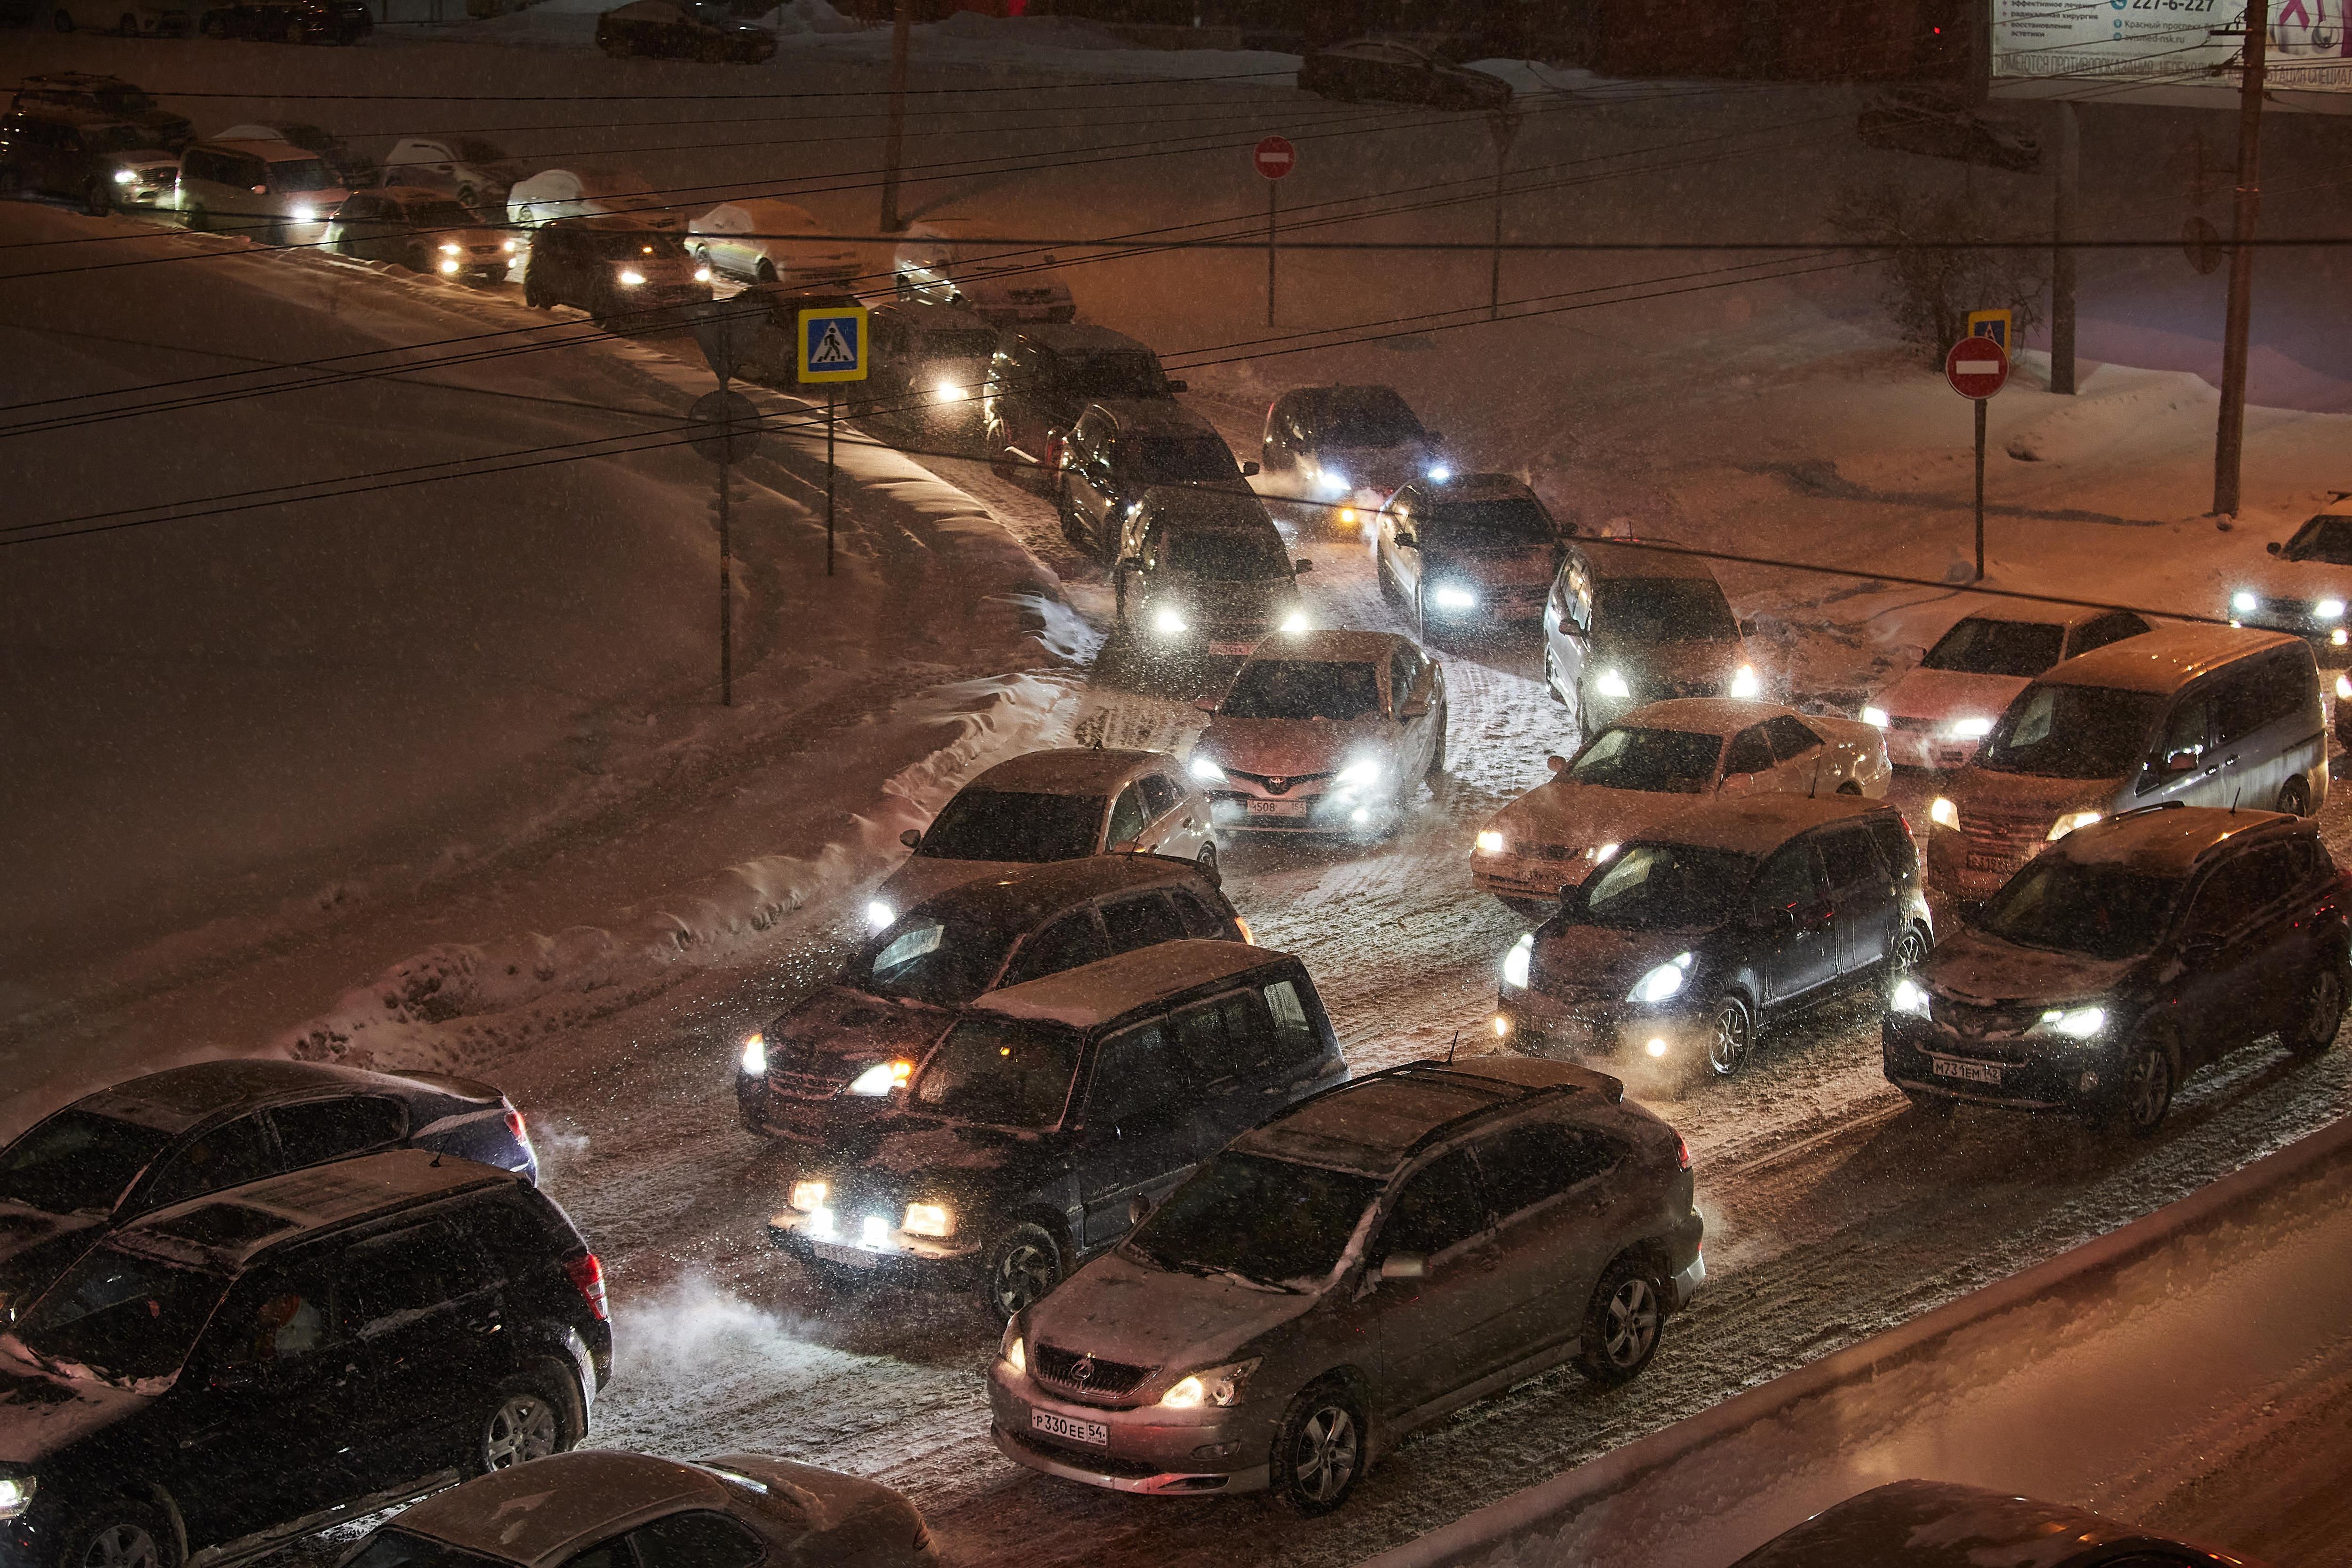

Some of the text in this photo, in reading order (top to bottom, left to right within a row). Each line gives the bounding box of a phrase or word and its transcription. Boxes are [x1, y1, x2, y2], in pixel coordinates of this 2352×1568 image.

[2133, 0, 2213, 12] 227-6-227
[2125, 20, 2160, 29] Красный
[2000, 54, 2049, 73] ИМЕЮТСЯ
[1936, 1062, 1979, 1078] М731ЕМ
[1037, 1415, 1102, 1439] Р330ЕЕ 54
